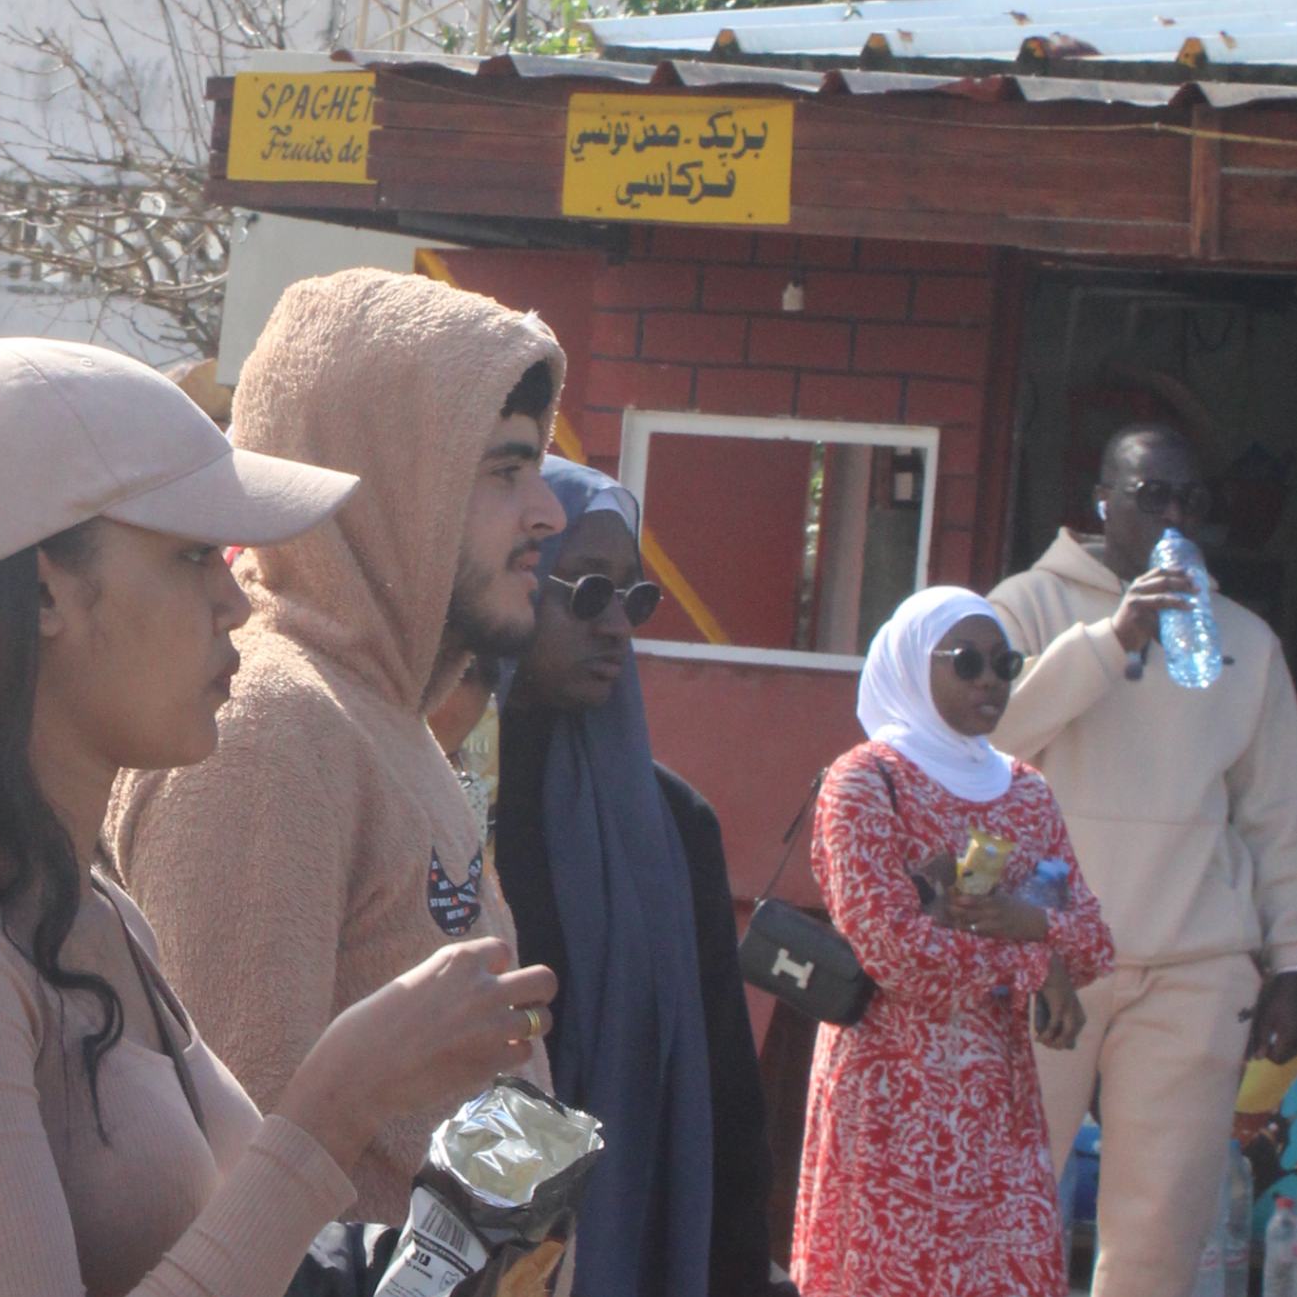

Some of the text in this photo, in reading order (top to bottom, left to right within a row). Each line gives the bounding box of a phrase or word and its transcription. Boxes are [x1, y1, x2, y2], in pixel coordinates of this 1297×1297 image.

[261, 124, 362, 163] Fruits de
[571, 111, 631, 161] تونسي
[633, 115, 680, 152] صحن
[699, 110, 768, 159] بريك
[616, 160, 736, 209] فركاسي
